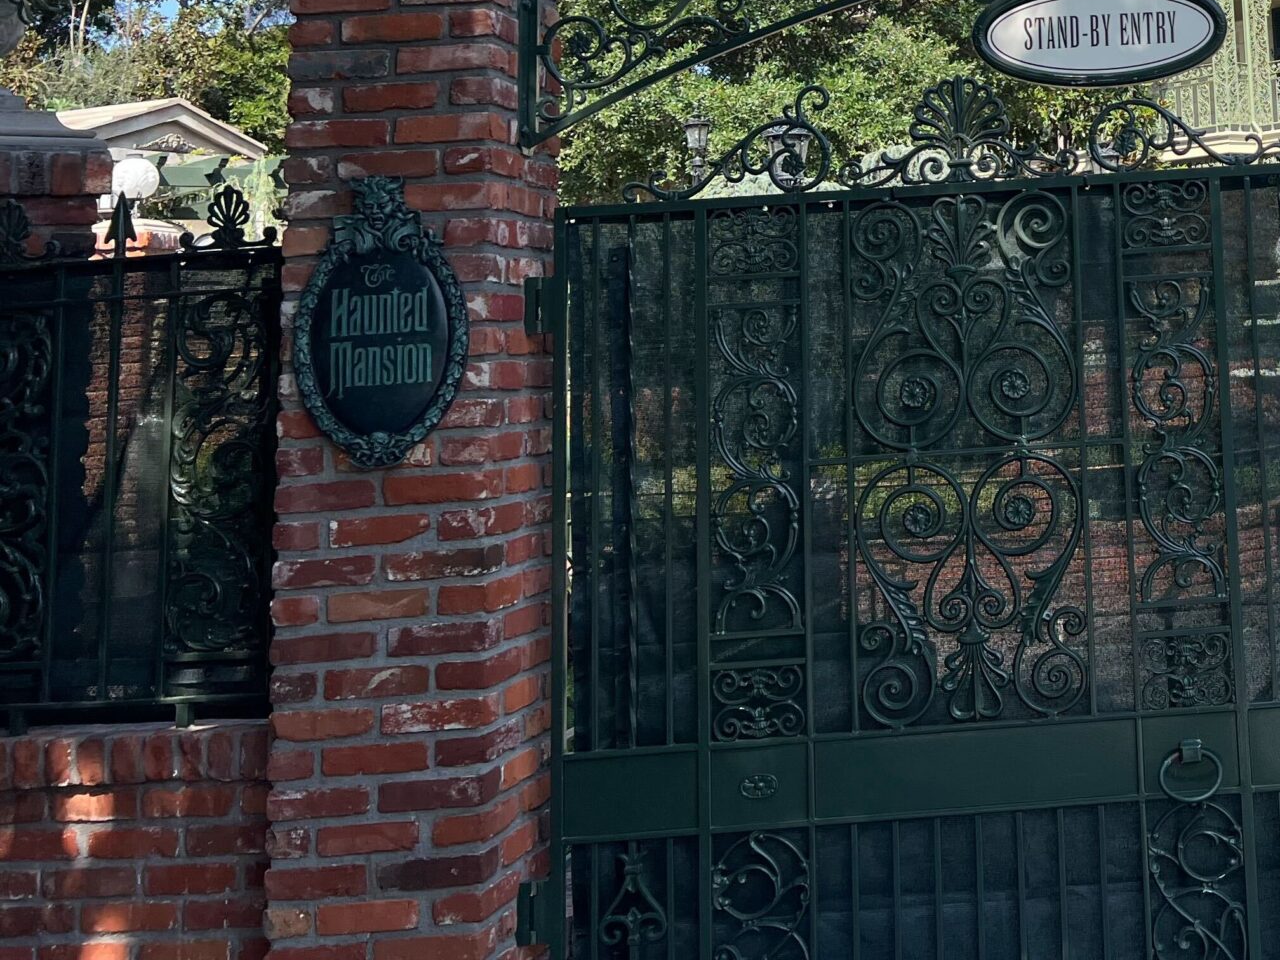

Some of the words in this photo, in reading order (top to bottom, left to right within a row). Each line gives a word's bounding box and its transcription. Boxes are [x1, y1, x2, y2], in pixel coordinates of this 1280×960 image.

[1023, 13, 1111, 50] STAND-BY
[1120, 10, 1177, 46] ENTRY
[360, 263, 397, 288] The
[329, 278, 430, 337] Haunted
[325, 337, 433, 400] Mansion
